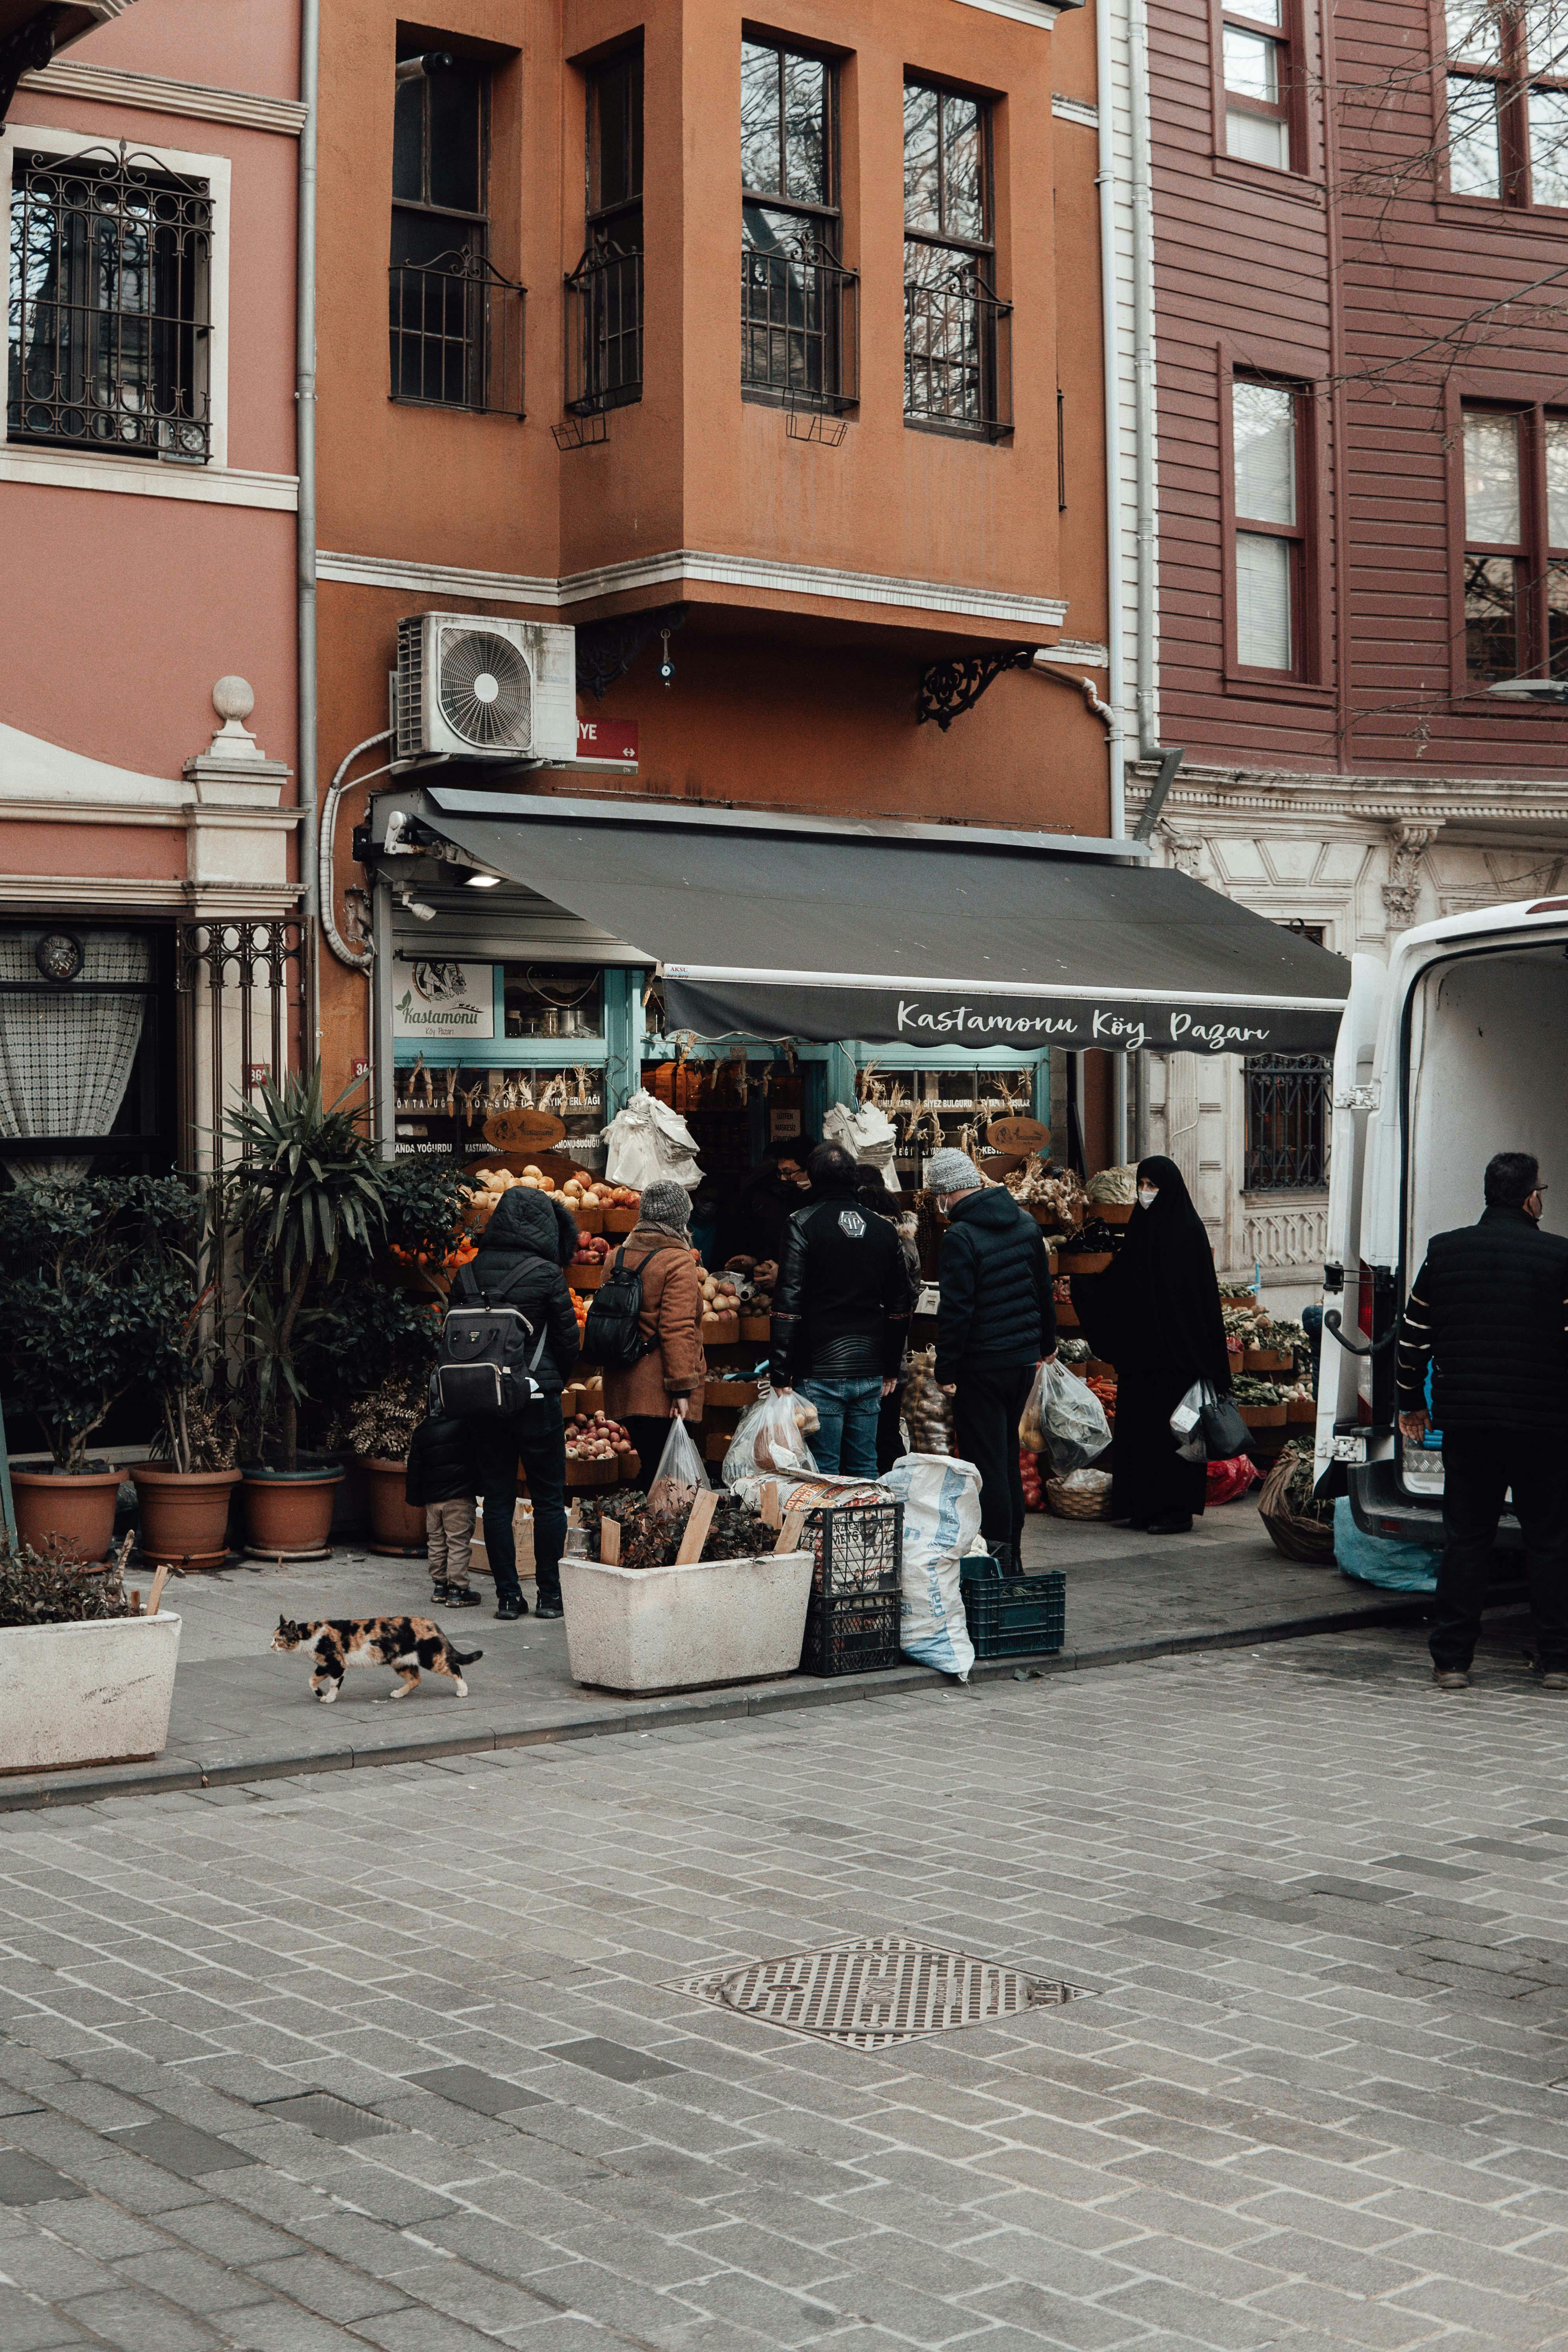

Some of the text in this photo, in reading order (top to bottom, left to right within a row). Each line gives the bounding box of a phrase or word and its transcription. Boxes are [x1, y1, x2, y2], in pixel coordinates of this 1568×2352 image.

[403, 1008, 478, 1024] Kastamonu
[897, 1001, 1270, 1049] Kastamonu Köy Pazarı
[426, 1027, 435, 1037] Köy
[943, 1099, 972, 1108] BULGURU
[777, 1111, 793, 1120] LÜTFEN
[775, 1123, 796, 1131] MASKESİZ
[417, 1142, 452, 1153] YOĞURDU
[576, 1138, 599, 1149] SUCUĞU
